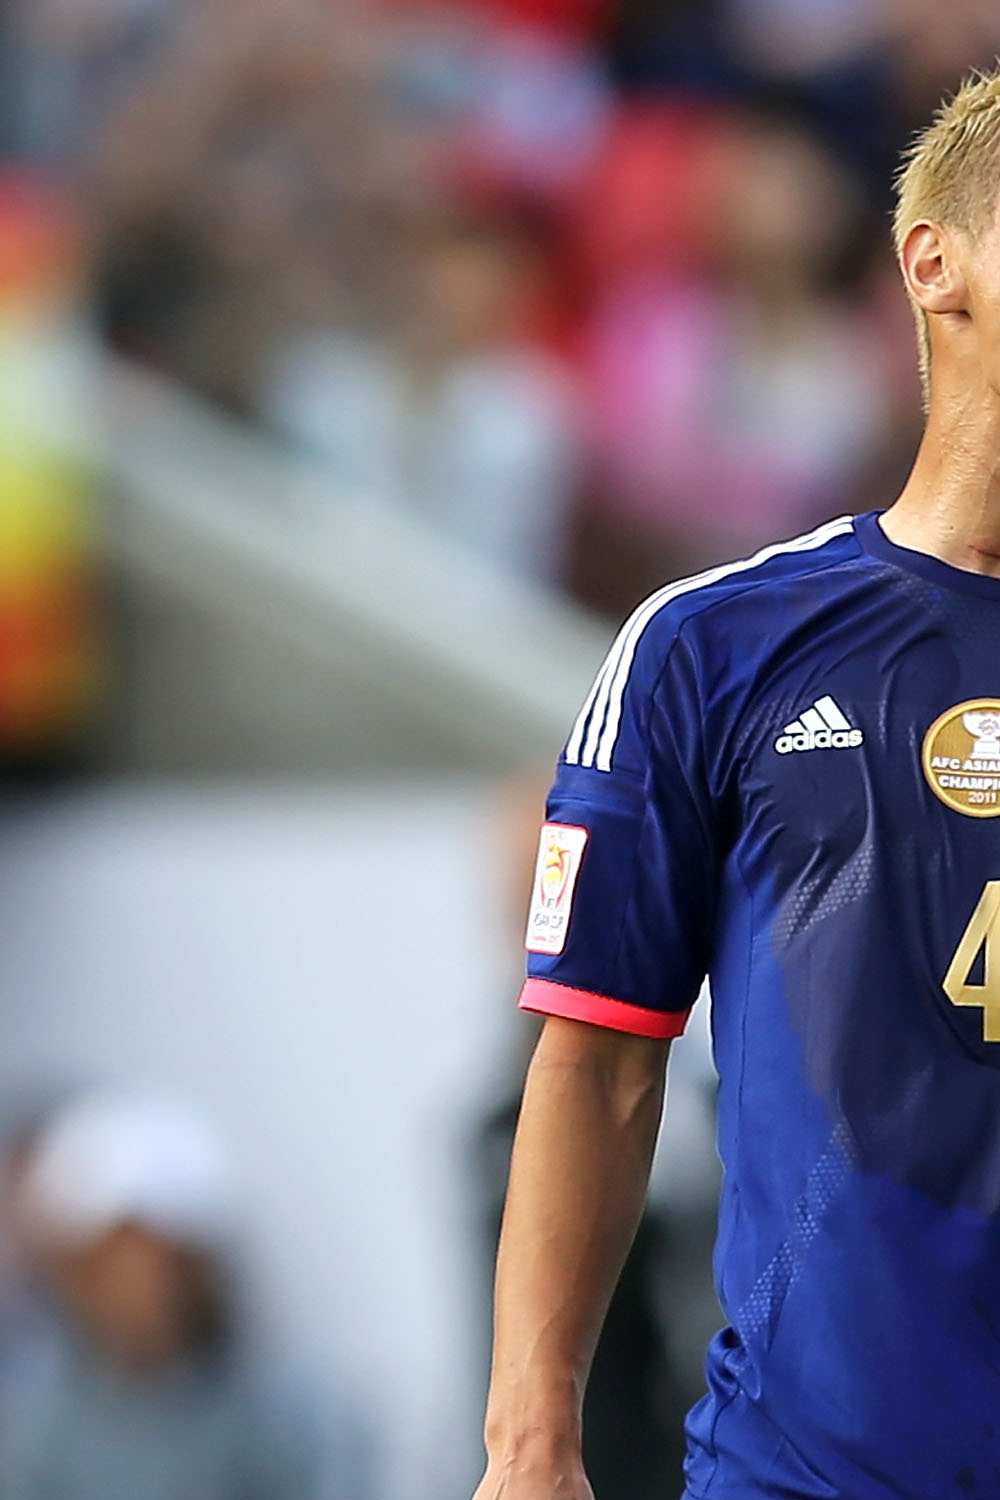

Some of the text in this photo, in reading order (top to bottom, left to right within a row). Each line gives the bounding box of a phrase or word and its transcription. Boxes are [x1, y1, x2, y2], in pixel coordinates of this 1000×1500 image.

[774, 729, 864, 754] adidas
[931, 756, 960, 769] AFC
[968, 791, 998, 803] 2011
